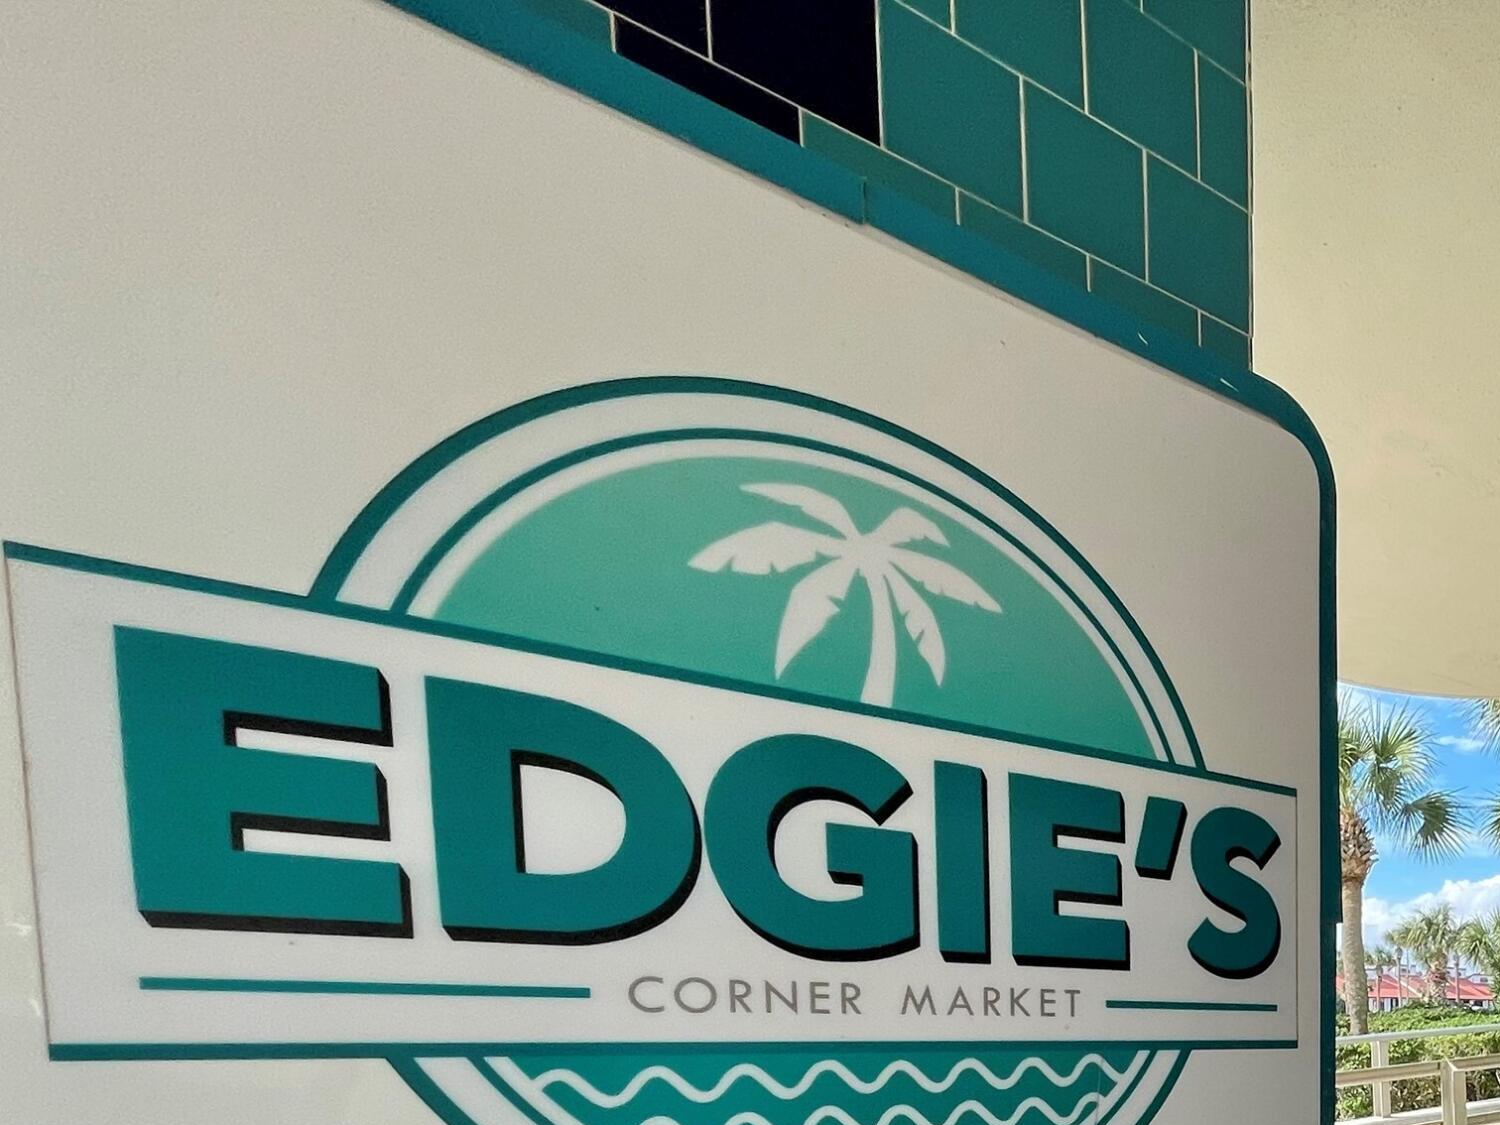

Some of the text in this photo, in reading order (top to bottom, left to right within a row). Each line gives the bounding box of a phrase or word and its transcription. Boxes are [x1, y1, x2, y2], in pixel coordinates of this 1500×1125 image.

[112, 624, 1282, 980] EDGIE'S
[627, 975, 1082, 1018] CORNER MARKET
